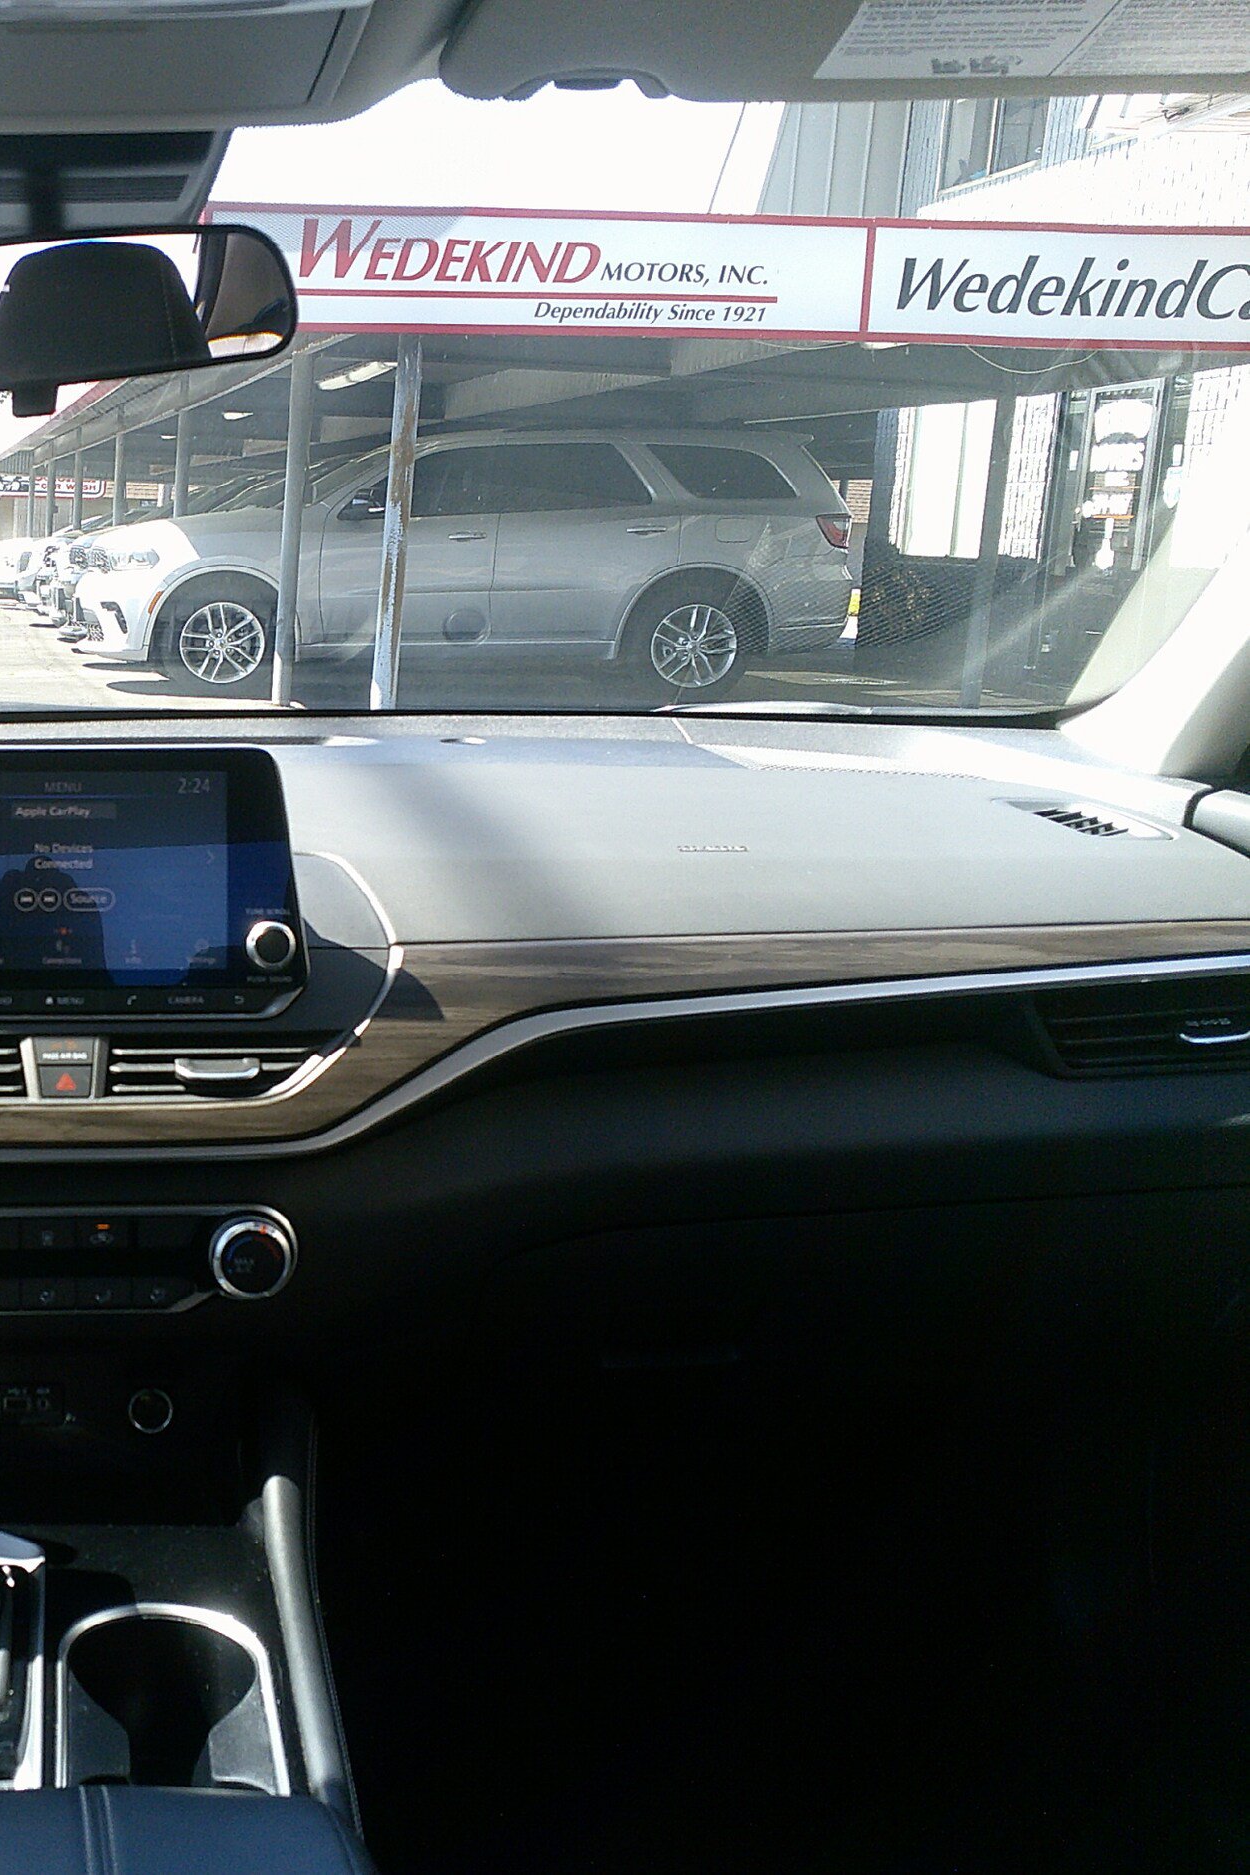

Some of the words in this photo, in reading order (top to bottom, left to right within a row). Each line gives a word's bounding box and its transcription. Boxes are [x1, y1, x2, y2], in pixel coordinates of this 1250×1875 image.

[299, 218, 602, 284] WEDEKIND
[600, 261, 710, 287] MOTORS,
[718, 265, 768, 285] INC.
[533, 302, 664, 324] Dependability
[667, 304, 716, 321] Since
[723, 306, 767, 322] 1921
[65, 483, 97, 491] WSH
[44, 781, 83, 793] MENU
[178, 777, 211, 794] 2:24
[15, 806, 47, 818] Apple
[49, 806, 91, 818] CarPlay
[34, 843, 49, 853] No
[52, 843, 93, 853] Devices
[34, 858, 93, 870] Connected
